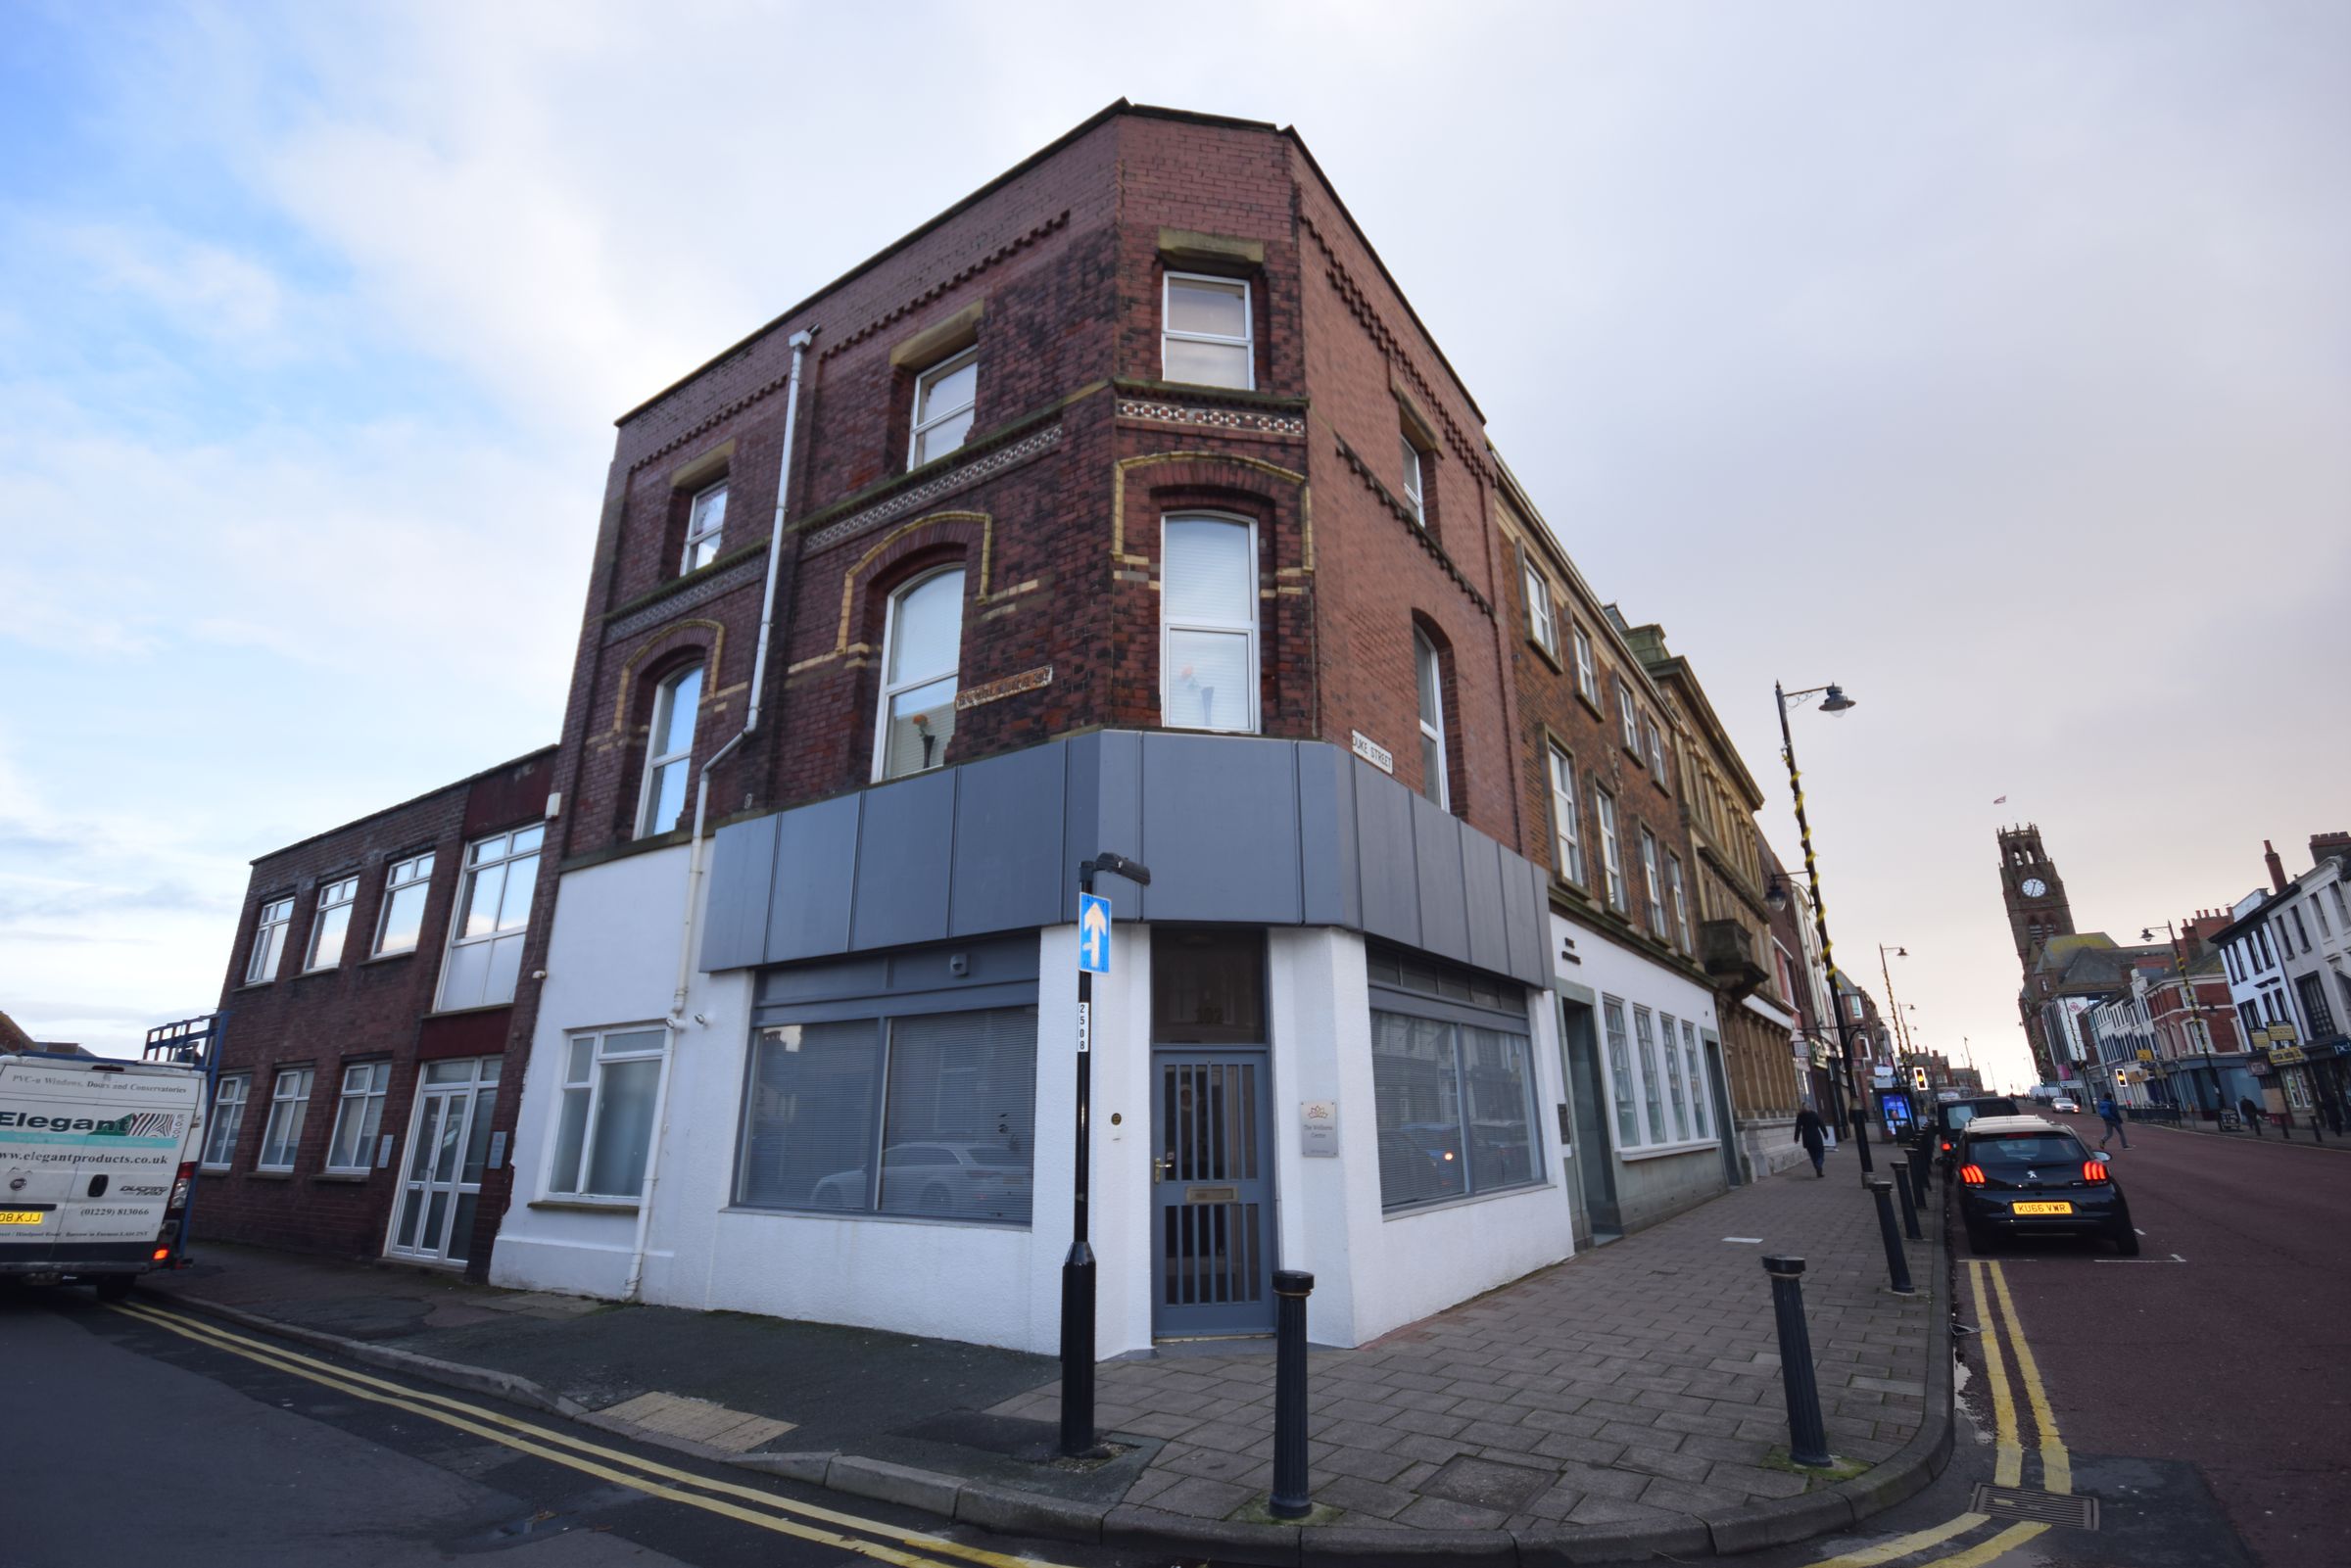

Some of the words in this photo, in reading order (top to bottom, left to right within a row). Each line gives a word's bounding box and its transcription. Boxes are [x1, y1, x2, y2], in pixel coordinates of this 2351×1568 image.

[1370, 746, 1391, 769] STREET
[130, 1083, 186, 1093] Conservatories
[0, 1111, 128, 1132] Elegant
[80, 1208, 115, 1216] (01229)
[2017, 1204, 2044, 1212] KU66
[2046, 1204, 2067, 1212] VWR
[16, 1213, 41, 1222] KJJ
